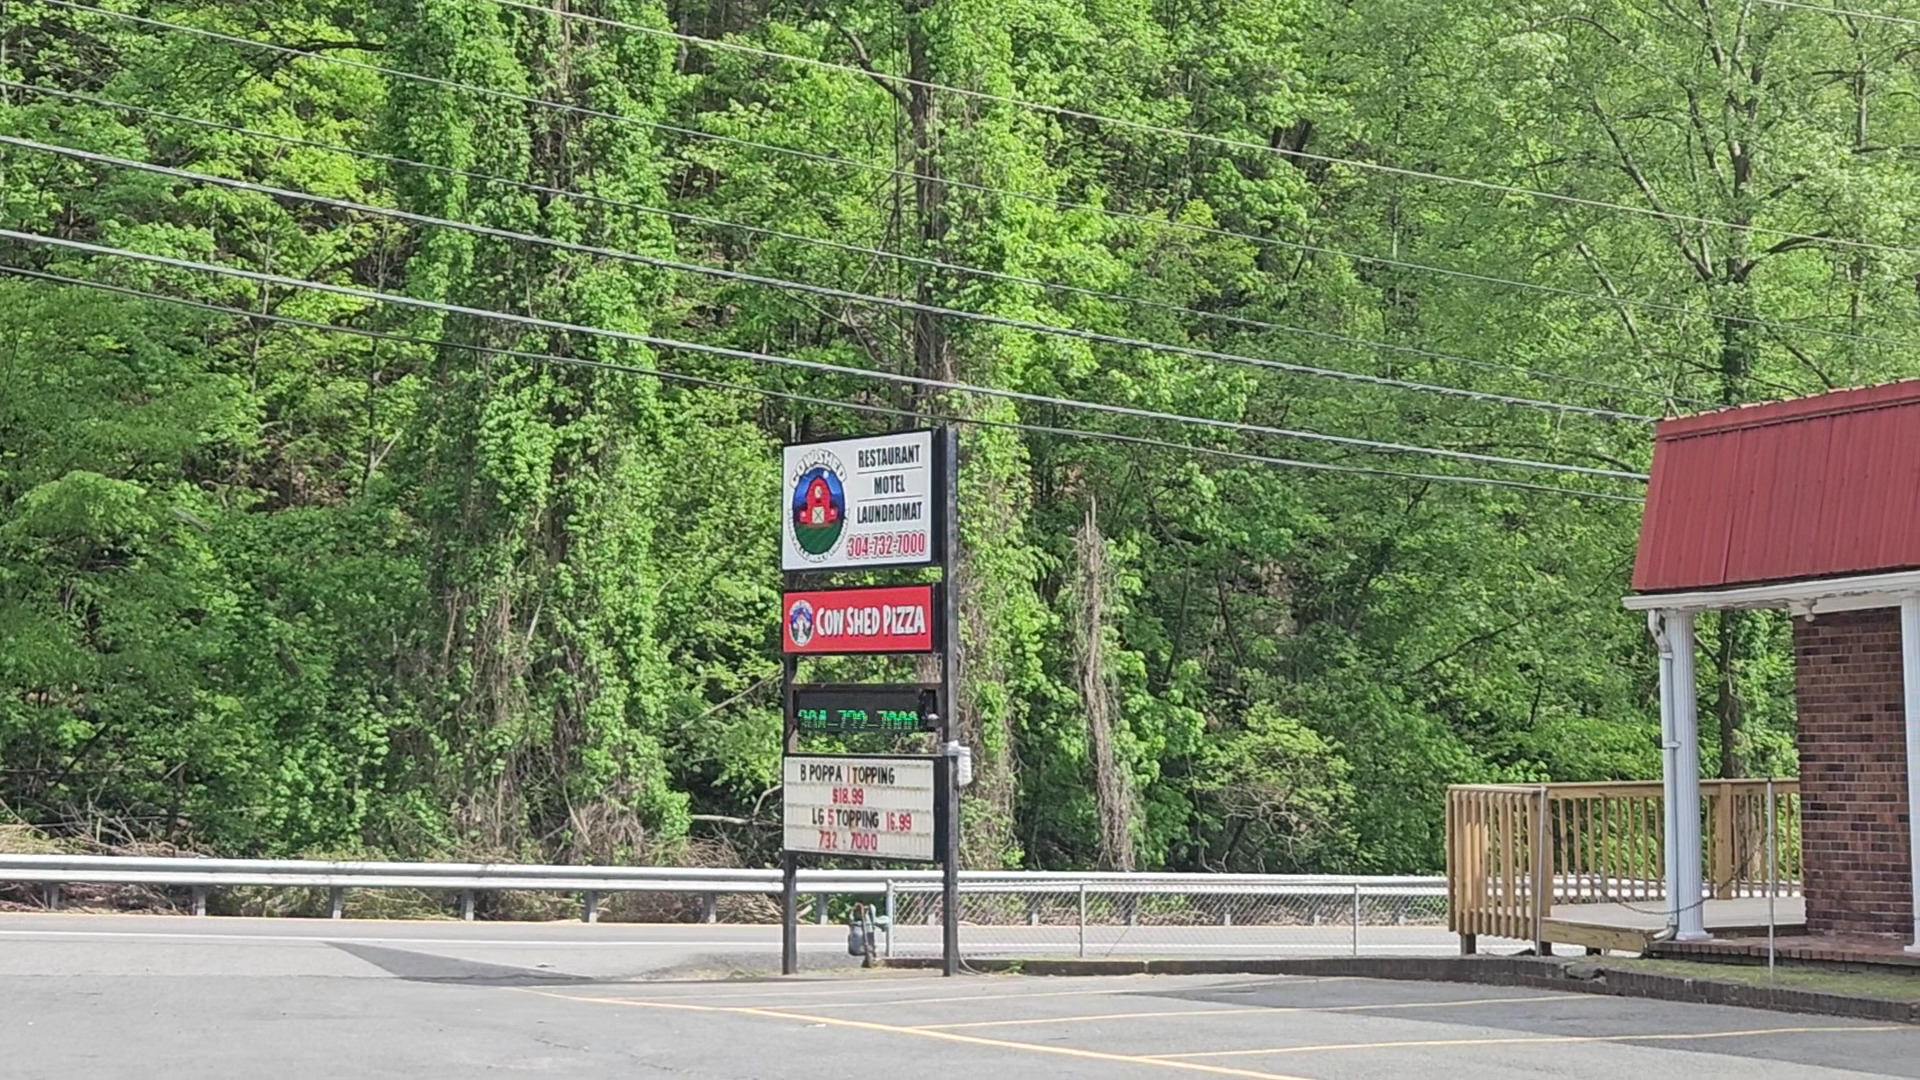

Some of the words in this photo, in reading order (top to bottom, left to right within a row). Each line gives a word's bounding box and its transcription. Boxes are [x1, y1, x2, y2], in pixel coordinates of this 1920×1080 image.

[858, 444, 921, 468] RESTAURANT
[874, 474, 906, 495] MOTEL
[857, 501, 922, 524] LAUNDROMAT
[847, 532, 926, 558] 304-732-7000
[816, 607, 844, 636] COW
[846, 606, 880, 636] SHED
[800, 764, 806, 781] B
[809, 765, 843, 782] POPPA
[852, 766, 895, 784] TOPPING
[832, 788, 864, 804] $18.99
[812, 808, 824, 825] LG
[836, 809, 879, 829] TOPPING
[819, 831, 838, 848] 732
[850, 832, 878, 850] 7000
